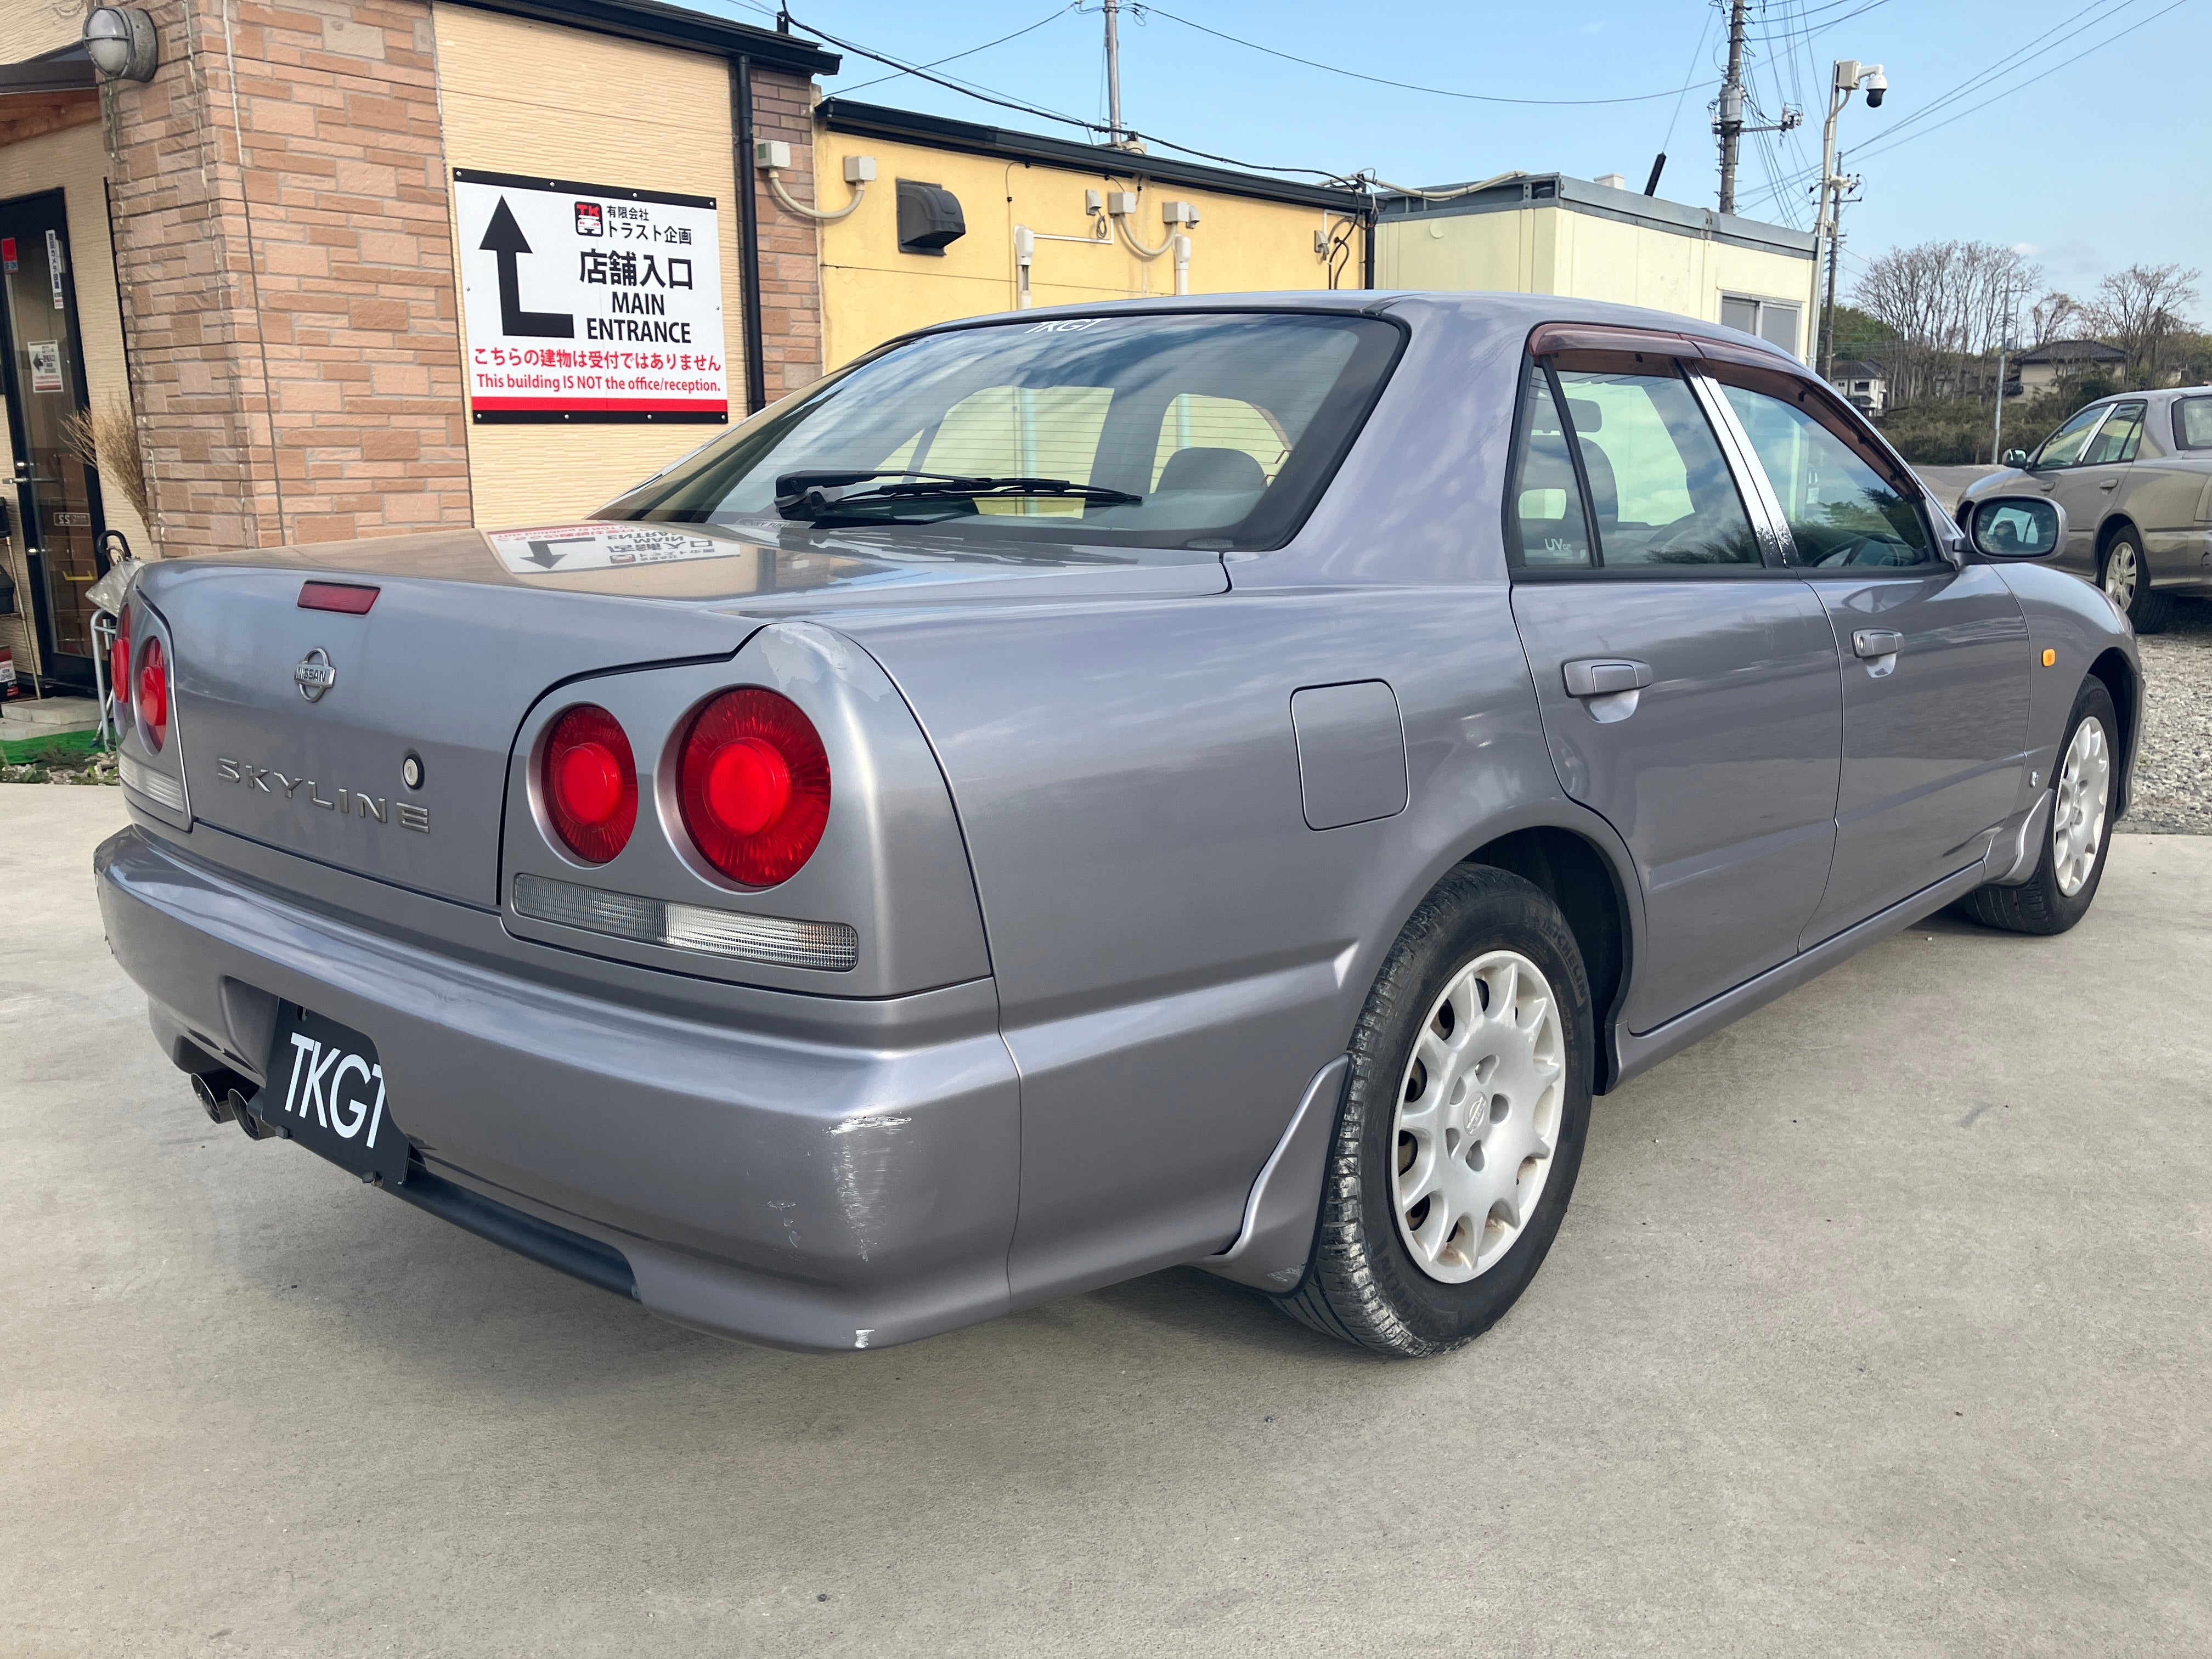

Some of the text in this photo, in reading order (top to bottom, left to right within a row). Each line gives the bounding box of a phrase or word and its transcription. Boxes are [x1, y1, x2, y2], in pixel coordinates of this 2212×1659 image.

[577, 204, 600, 217] TK
[607, 205, 650, 221] 有限会社
[609, 221, 692, 245] トラスト企画
[579, 248, 693, 290] 店舗入口
[612, 291, 665, 315] MAIN
[586, 318, 691, 343] ENTRANCE
[1024, 318, 1111, 334] TKGT
[475, 347, 721, 371] こちらの建物は受付ではありません
[477, 374, 721, 394] This building IS NOT the office/reception.
[1544, 538, 1562, 551] UV
[296, 667, 326, 682] NISSAN
[217, 758, 430, 833] SKYLINE
